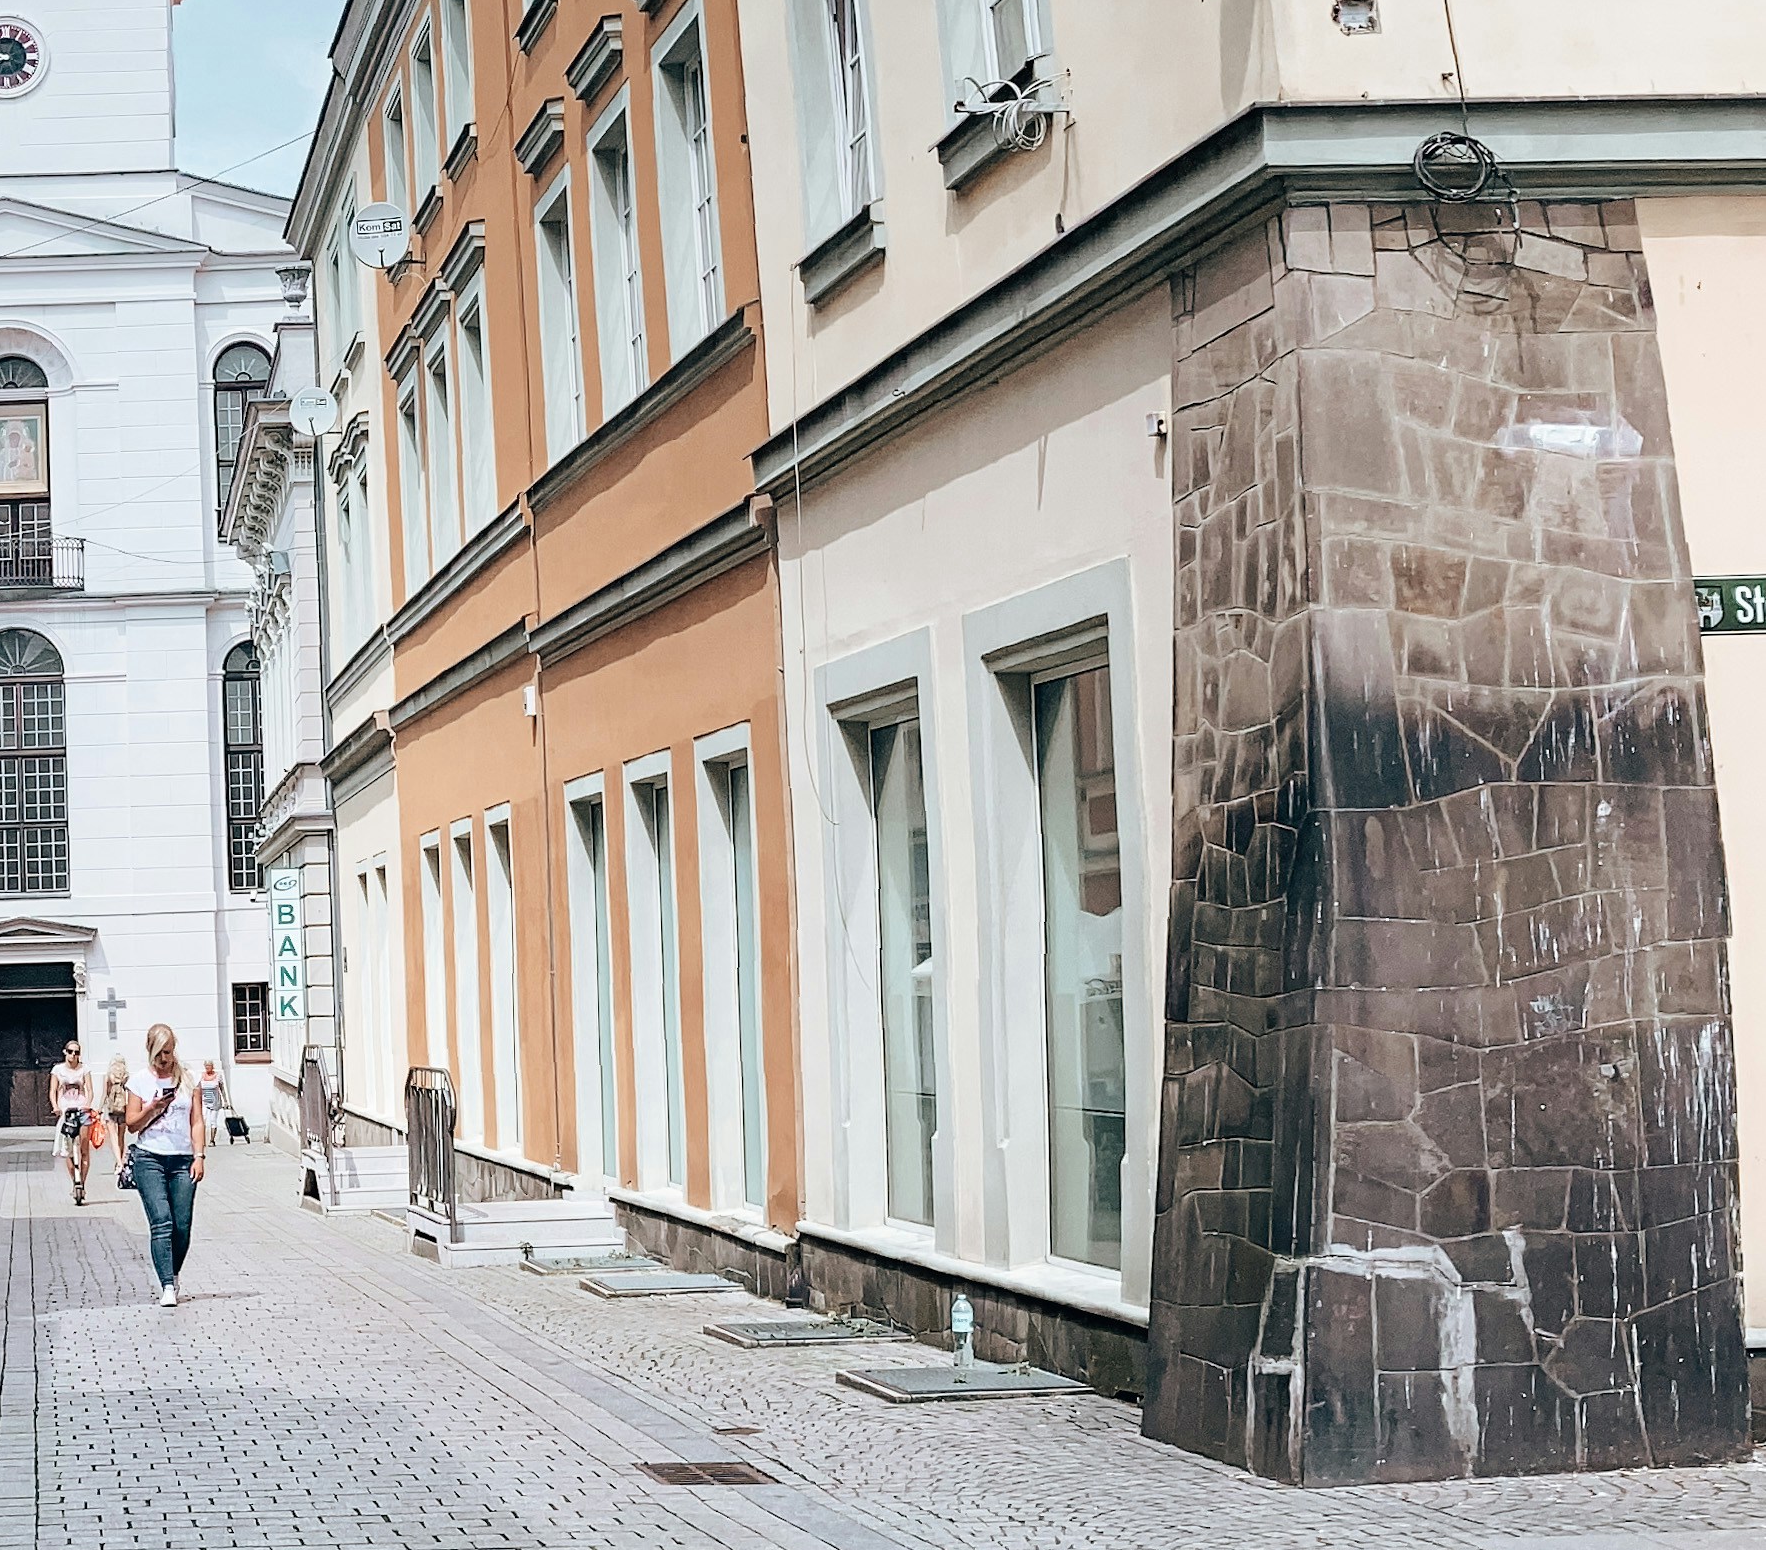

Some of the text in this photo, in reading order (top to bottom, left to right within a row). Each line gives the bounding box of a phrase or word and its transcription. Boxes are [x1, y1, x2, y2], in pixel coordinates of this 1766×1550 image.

[359, 221, 401, 232] Kom Sat
[277, 904, 299, 1017] BANK
